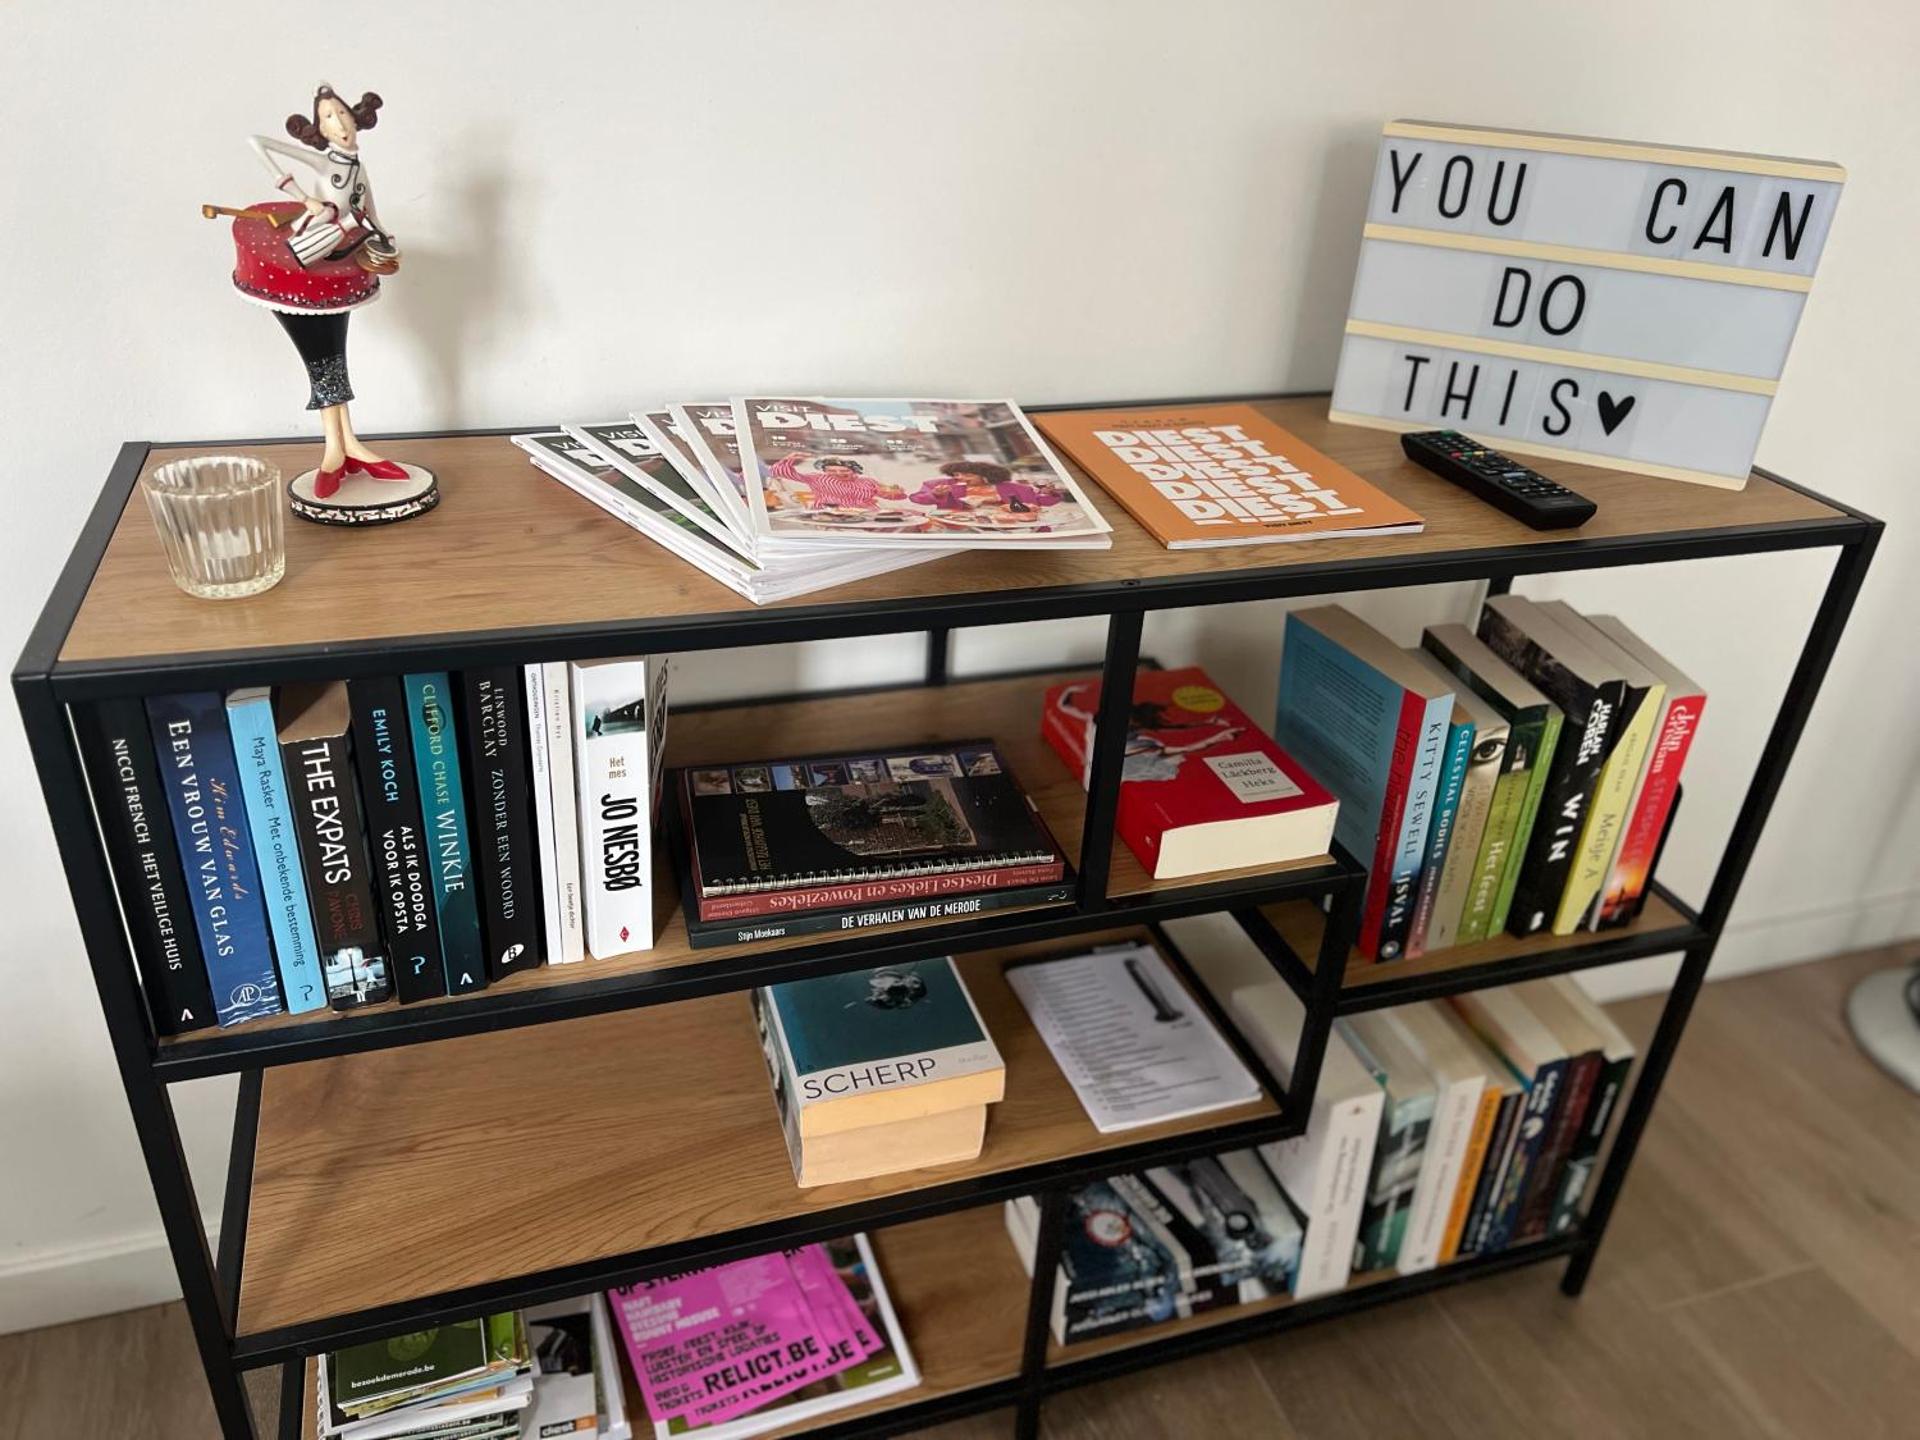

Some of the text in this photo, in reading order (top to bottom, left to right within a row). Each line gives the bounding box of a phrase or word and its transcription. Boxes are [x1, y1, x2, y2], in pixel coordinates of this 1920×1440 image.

[1389, 149, 1816, 261] YOU CAN
[1492, 266, 1587, 337] DO
[755, 404, 811, 413] VISIT
[756, 411, 939, 433] DIEST
[1403, 354, 1580, 437] THIS
[1093, 424, 1250, 447] DIEST
[1110, 439, 1271, 464] DIEST
[1149, 472, 1321, 500] DIEST
[1171, 489, 1349, 522] DIEST
[479, 680, 498, 758] BARCLAY
[493, 688, 507, 747] LINWOOD
[1576, 699, 1604, 766] COBEN
[1590, 703, 1613, 755] HARLAN
[372, 708, 399, 802] EMILY KOCH
[608, 768, 627, 779] mes
[609, 756, 625, 767] Het
[1421, 722, 1442, 783] KITTY
[301, 742, 352, 885] THE EXPATS
[421, 683, 464, 894] CLIFFORD CHASE WINKIE
[1432, 729, 1471, 859] CELESTIAL BODIES
[168, 719, 235, 957] EEN VROUW VAN GLAS
[253, 736, 266, 768] Maya
[260, 770, 275, 809] Rasker
[274, 843, 293, 903] onbekende
[286, 904, 306, 968] bestemming
[491, 769, 516, 921] ZONDER EEN WOORD
[601, 793, 643, 892] JO NESBØ
[1403, 790, 1428, 859] SEWELL
[1548, 792, 1584, 863] WIN
[1588, 813, 1617, 862] Meisje
[112, 738, 183, 971] NICCI FRENCH HET VEILIGE HUIS
[382, 830, 406, 935] VOOR IK OPSTA
[400, 826, 427, 932] ALS IK DOODGA
[944, 872, 998, 890] Diestse
[1585, 867, 1599, 880] A
[769, 886, 863, 911] Poweziekes
[841, 900, 981, 929] DE VERHALEN VAN DE MERODE
[867, 886, 886, 898] en
[889, 879, 942, 896] Liekes
[737, 931, 754, 942] Stijn
[803, 1057, 937, 1099] SCHERP
[350, 1363, 436, 1389] bezoekdemerode.be
[703, 1336, 821, 1396] RELICT.BE
